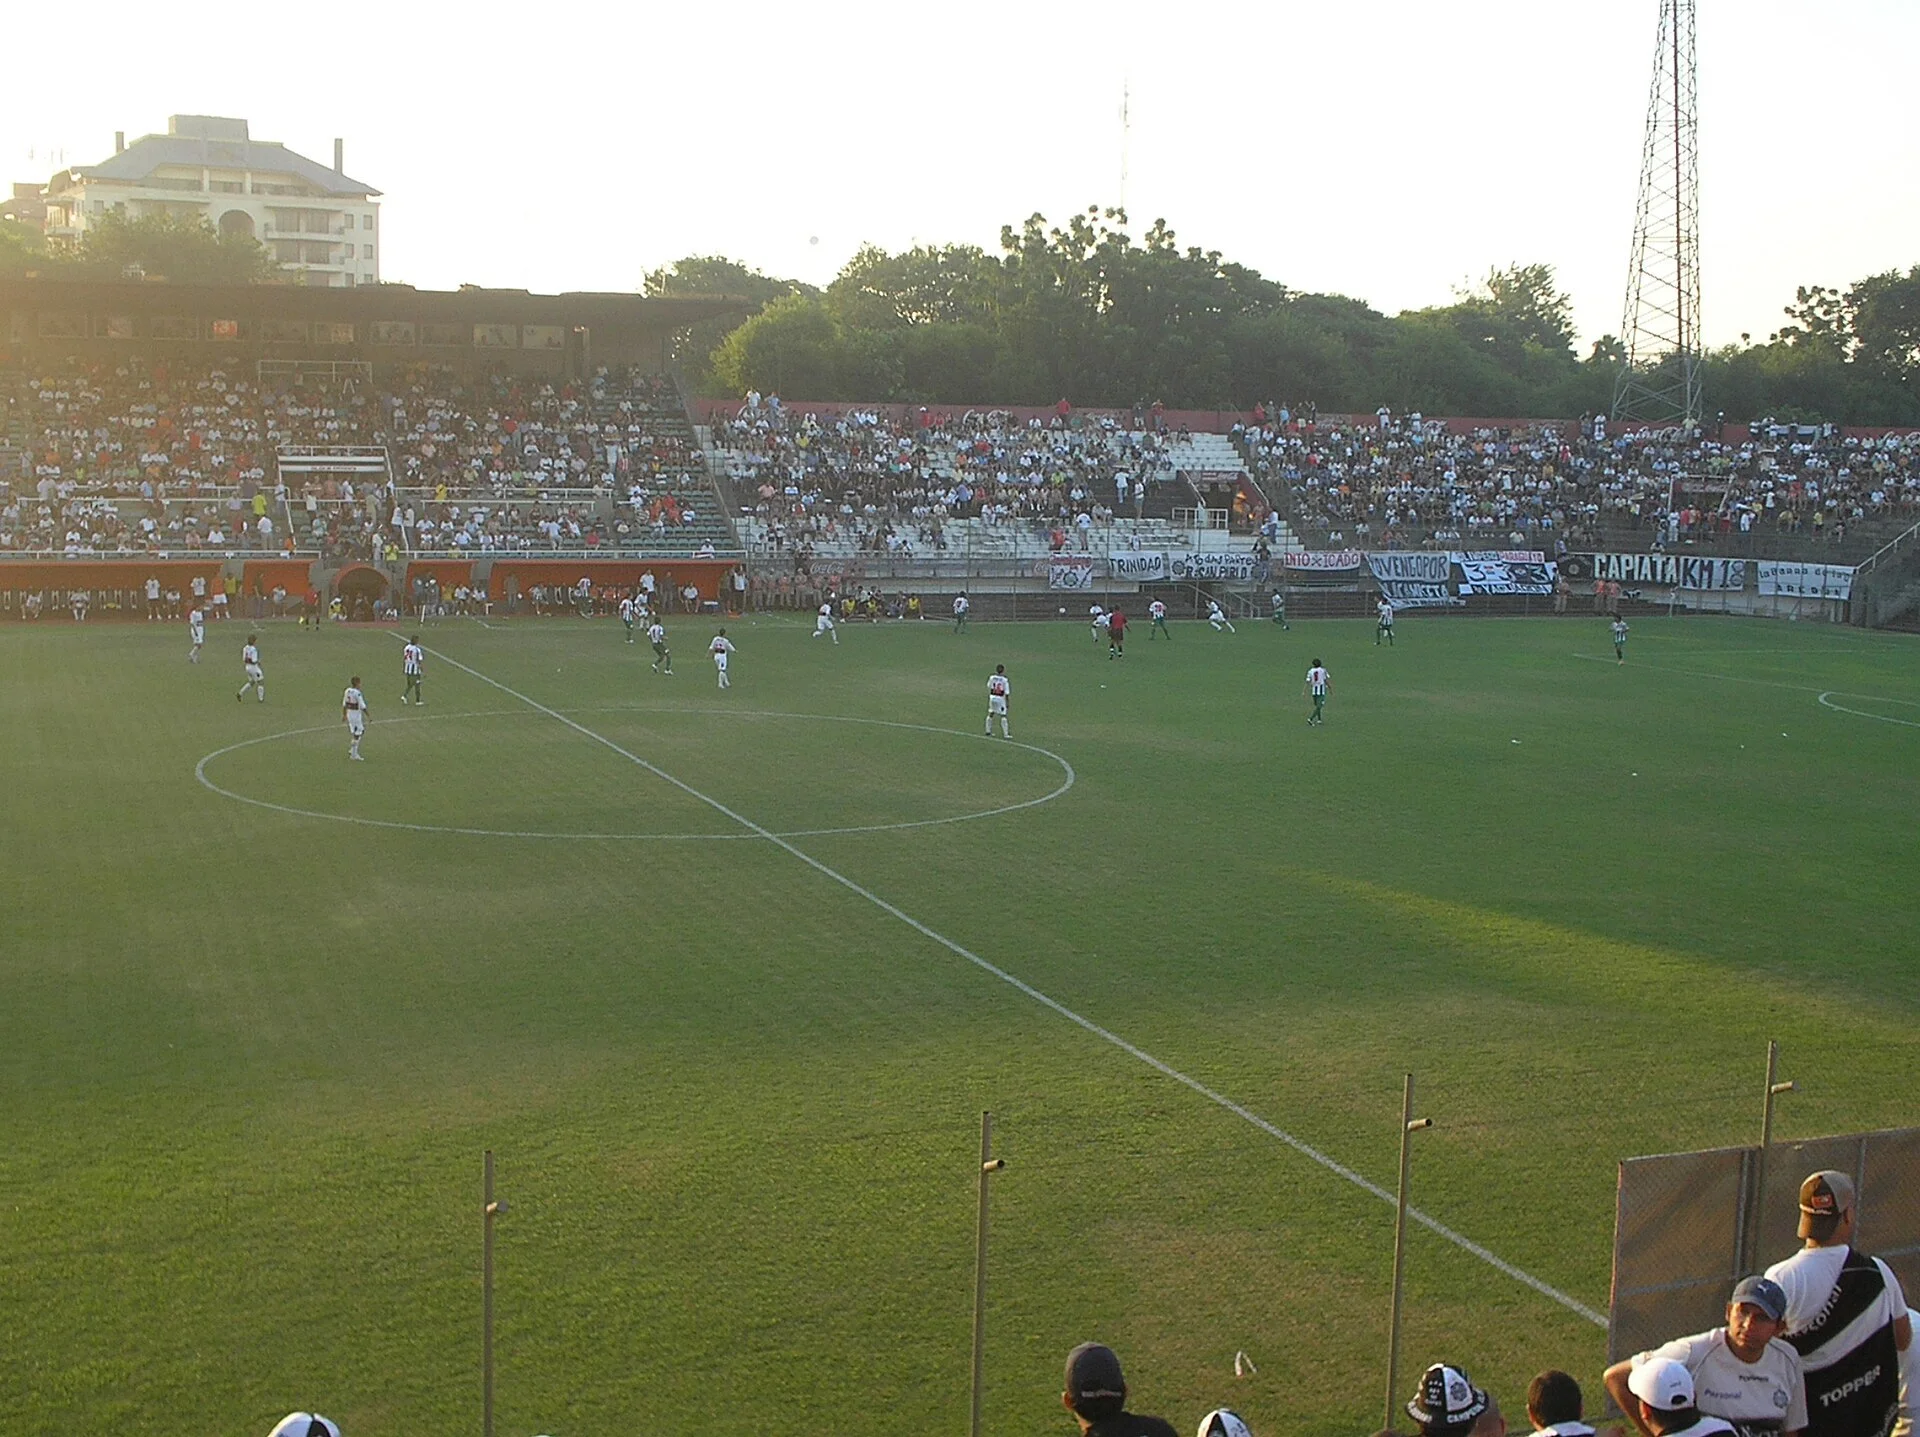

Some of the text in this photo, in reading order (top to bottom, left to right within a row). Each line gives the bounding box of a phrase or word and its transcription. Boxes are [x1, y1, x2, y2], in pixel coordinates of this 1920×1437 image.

[1109, 556, 1161, 574] TRINIDAD
[1594, 553, 1678, 584] CAPIATA
[1681, 557, 1714, 589] KM
[1704, 1388, 1742, 1400] Personal
[1819, 1364, 1881, 1407] TOPPER
